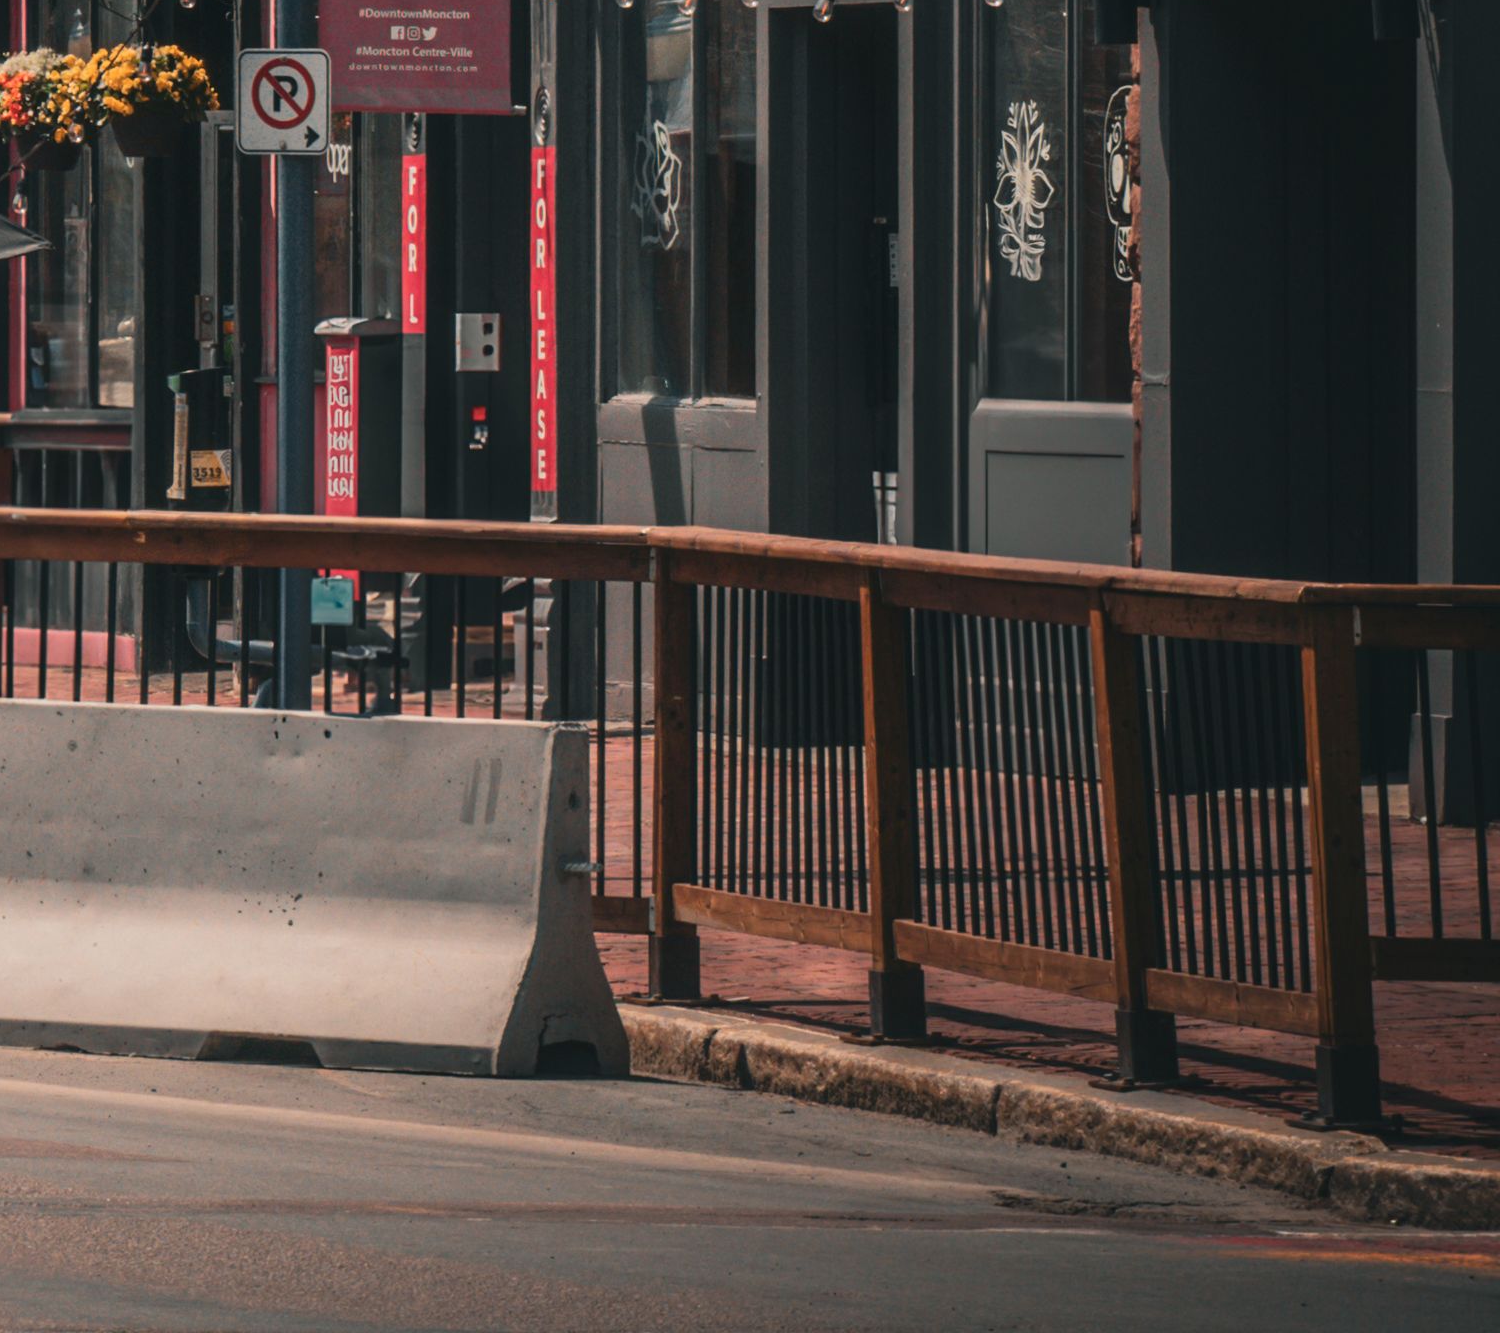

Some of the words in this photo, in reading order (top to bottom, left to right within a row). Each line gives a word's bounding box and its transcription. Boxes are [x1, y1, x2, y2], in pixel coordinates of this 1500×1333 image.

[358, 8, 471, 20] #DowntownMoncton
[348, 63, 479, 72] downtownmoncton.com
[355, 46, 410, 57] #Moncton
[412, 47, 473, 58] Centre-Ville
[408, 165, 418, 272] FOR
[536, 158, 547, 269] FOR
[536, 290, 548, 479] LEASE
